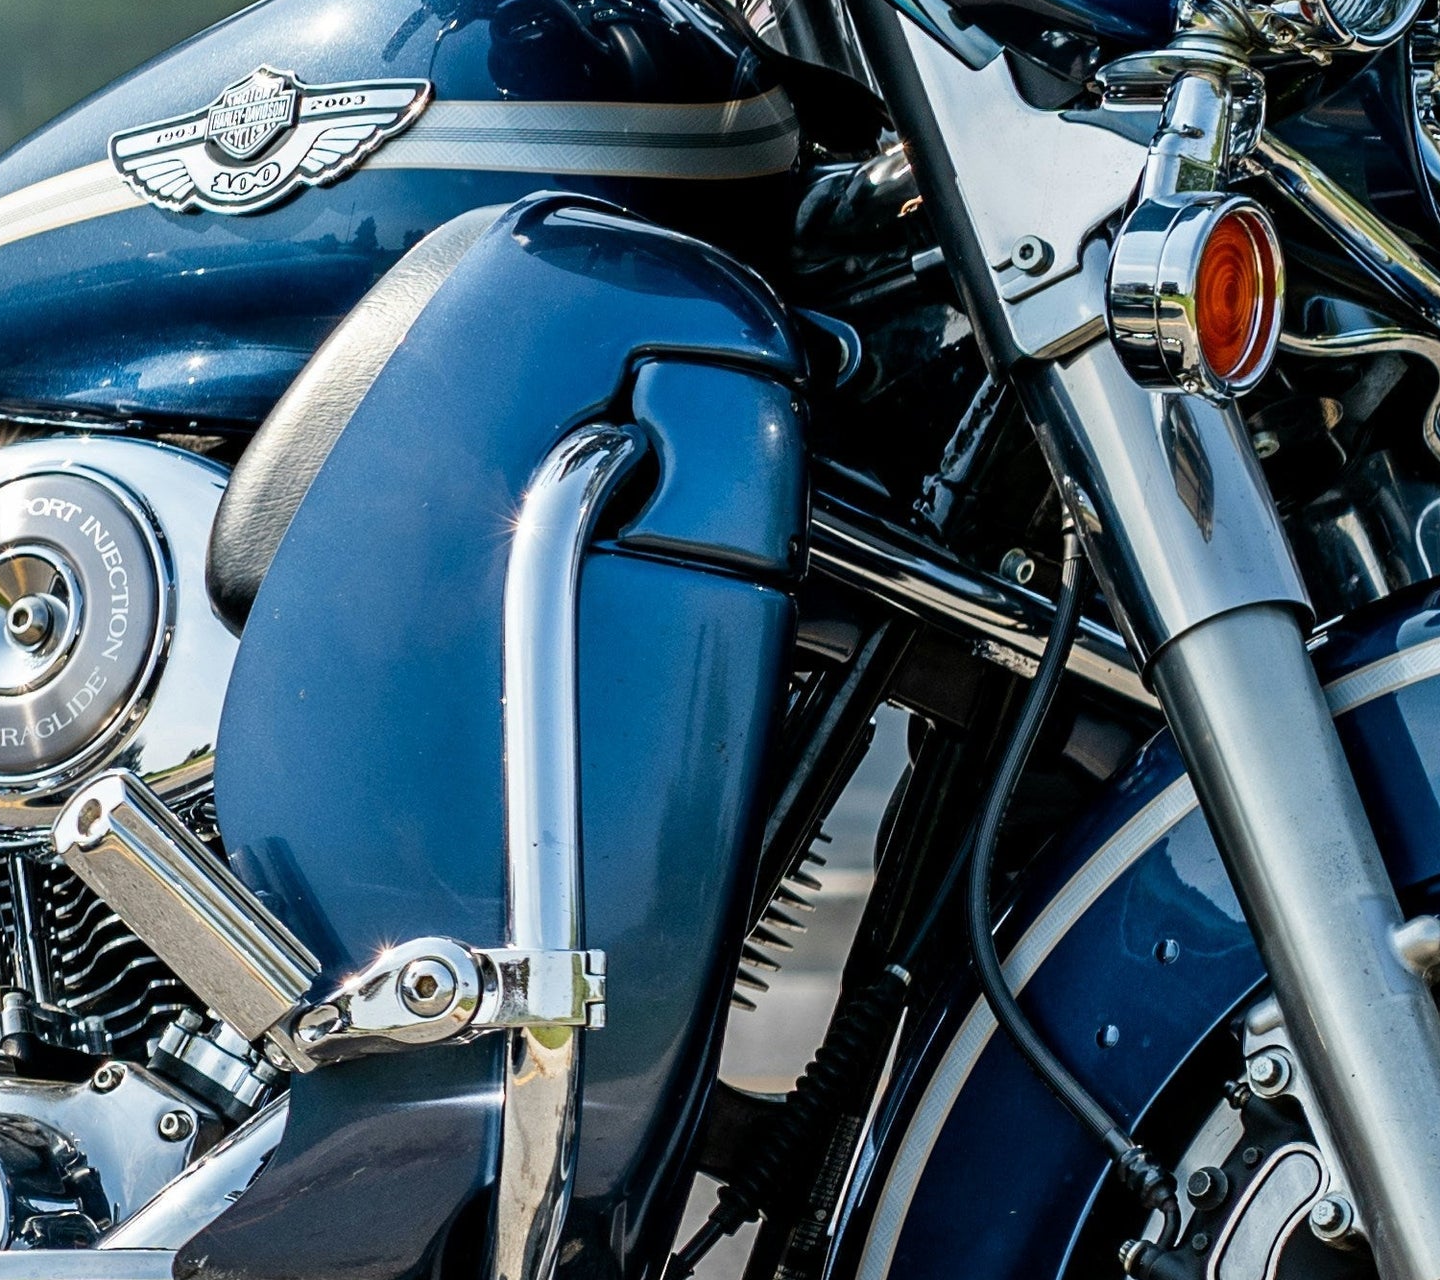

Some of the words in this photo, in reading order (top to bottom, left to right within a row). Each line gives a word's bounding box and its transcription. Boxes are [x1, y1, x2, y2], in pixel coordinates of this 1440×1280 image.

[309, 93, 367, 111] 2003
[155, 124, 197, 145] 1903
[211, 162, 281, 196] 100
[81, 514, 129, 663] INJECTION
